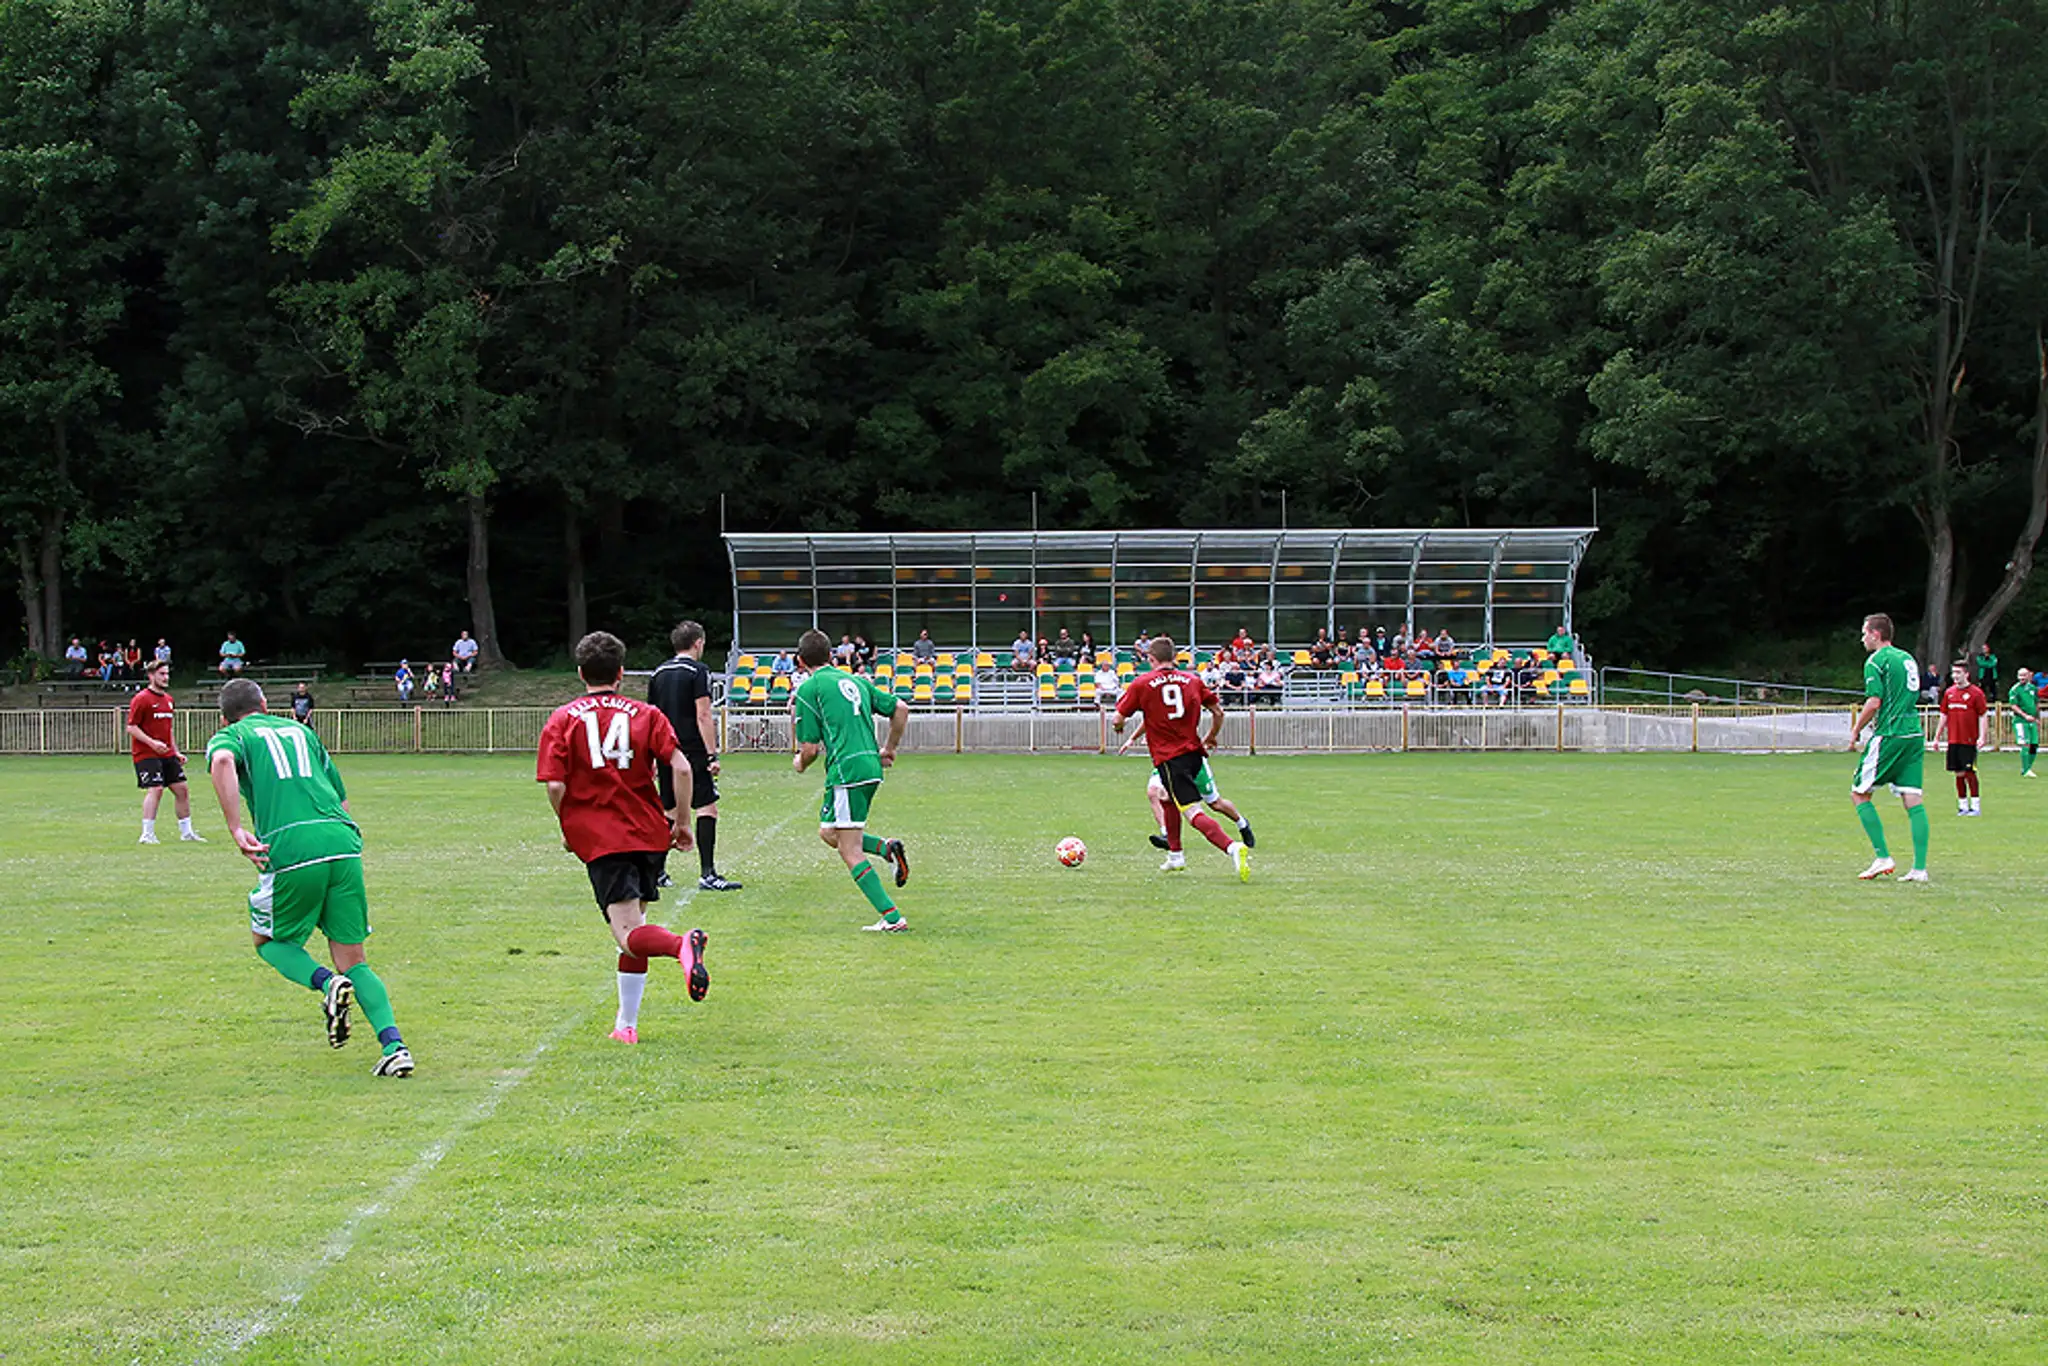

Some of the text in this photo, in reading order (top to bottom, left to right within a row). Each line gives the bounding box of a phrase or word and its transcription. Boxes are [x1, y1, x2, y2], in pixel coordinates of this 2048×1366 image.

[838, 678, 861, 716] 9
[1162, 683, 1185, 720] 9
[253, 726, 313, 779] 17
[580, 711, 634, 769] 14
